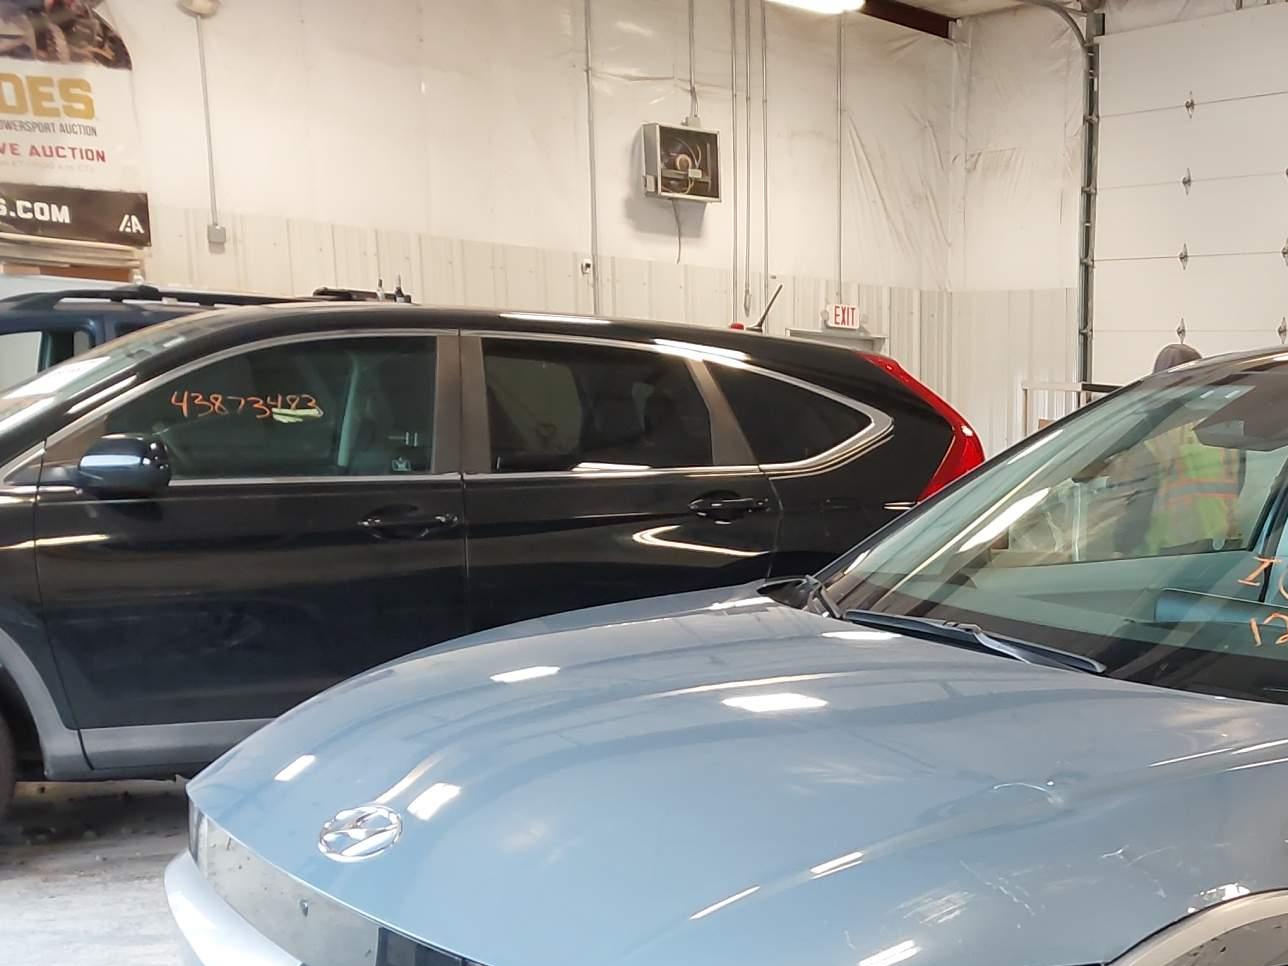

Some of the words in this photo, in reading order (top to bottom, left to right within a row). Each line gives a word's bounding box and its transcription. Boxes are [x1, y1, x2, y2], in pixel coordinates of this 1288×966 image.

[59, 122, 97, 136] AUCTION
[29, 144, 106, 162] AUCTION
[834, 304, 856, 326] EXIT
